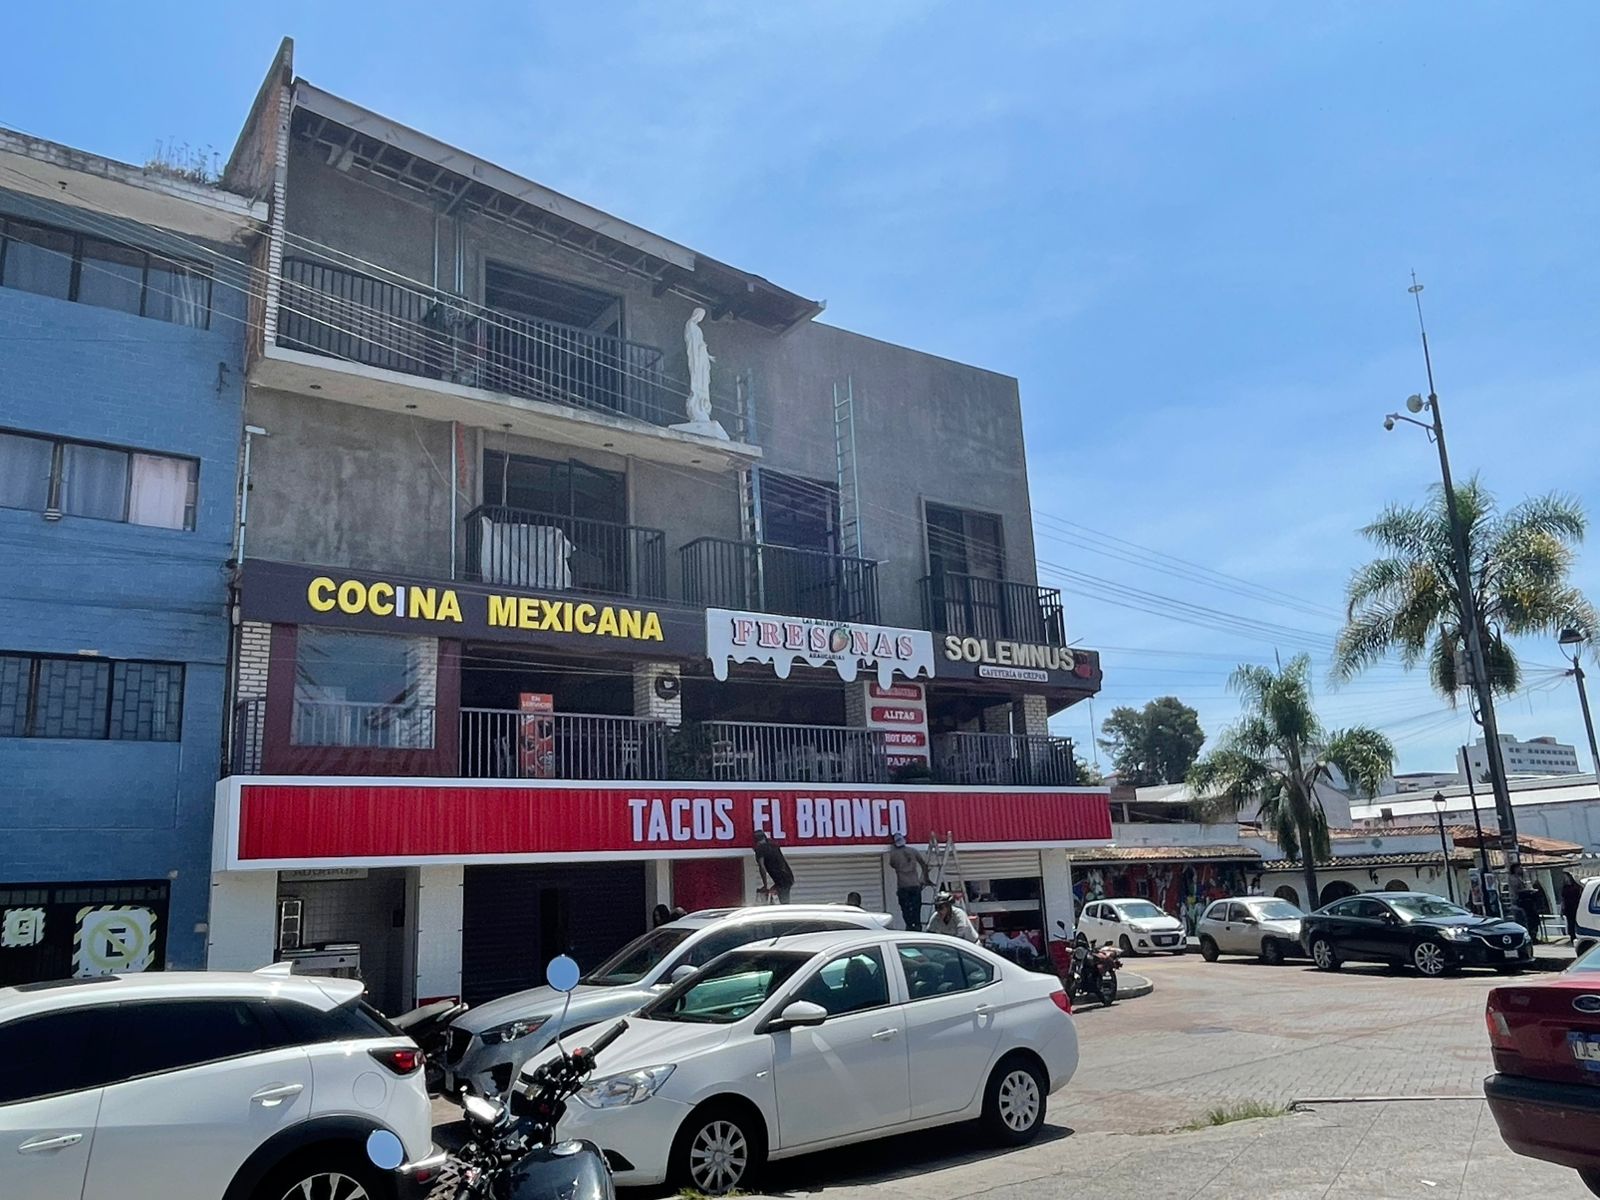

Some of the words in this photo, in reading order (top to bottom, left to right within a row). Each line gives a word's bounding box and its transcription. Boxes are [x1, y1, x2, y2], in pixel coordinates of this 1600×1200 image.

[307, 576, 463, 622] COCINA
[487, 594, 665, 641] MEXICANA
[945, 635, 1075, 671] SOLEMNUS
[883, 710, 915, 721] ALITAS
[901, 734, 917, 743] DOG
[627, 797, 735, 842] TACOS
[752, 797, 786, 839] EL
[796, 797, 908, 839] BRONCO
